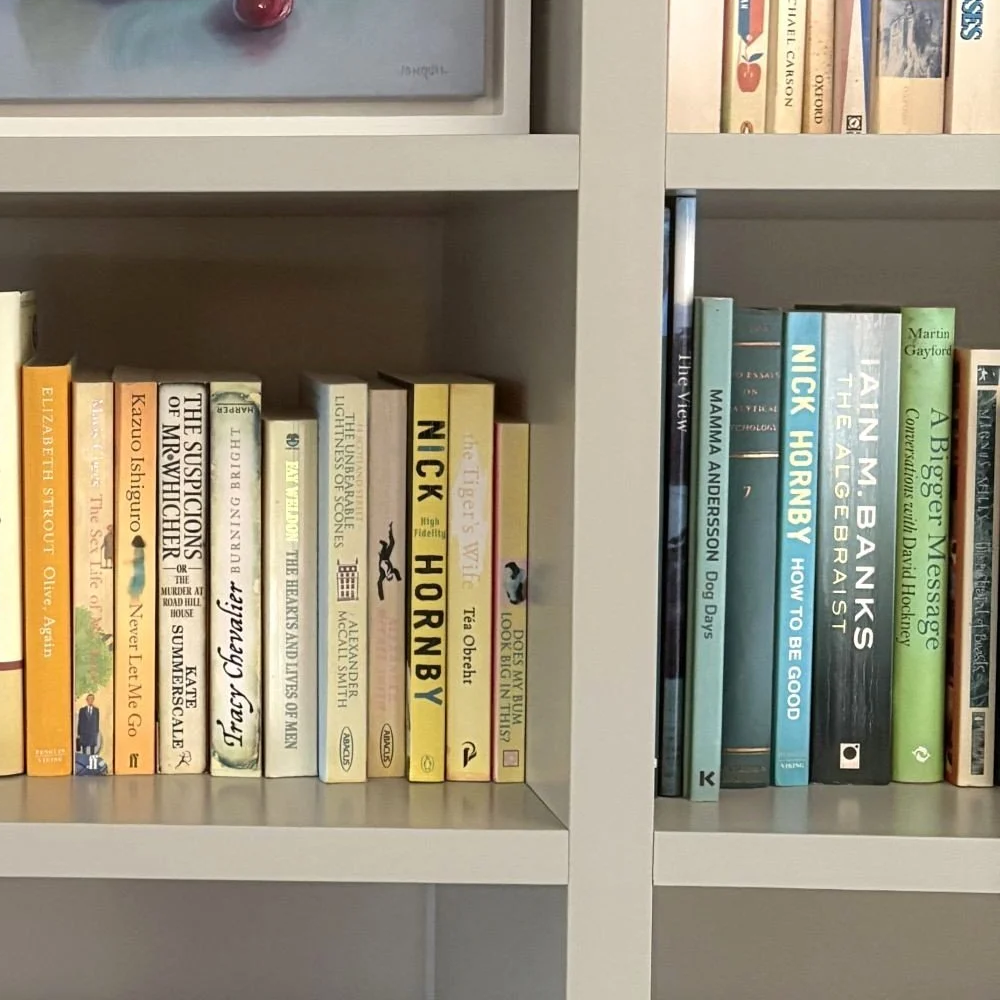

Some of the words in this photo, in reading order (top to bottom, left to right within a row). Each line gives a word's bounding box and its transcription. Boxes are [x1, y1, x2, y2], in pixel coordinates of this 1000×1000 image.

[783, 50, 797, 107] CARSON
[790, 344, 816, 414] NICK
[858, 359, 880, 441] IAIN
[130, 393, 145, 451] Kazuo
[184, 393, 202, 435] THE
[709, 390, 723, 455] MAMMA
[930, 408, 949, 427] A
[416, 421, 445, 502] NICK
[786, 430, 814, 544] HORNBY
[920, 437, 950, 527] Bigger
[126, 457, 145, 532] Ishiguro
[183, 442, 202, 560] SUSPICIONS
[706, 461, 722, 562] ANDERSSON
[702, 571, 717, 599] Dog
[790, 558, 804, 601] HOW
[853, 505, 875, 650] BANKS
[917, 535, 946, 650] Message
[129, 604, 143, 650] Never
[216, 581, 243, 678] Chevalier
[413, 555, 444, 706] HORNBY
[463, 608, 476, 630] Téa
[702, 605, 717, 639] Days
[790, 606, 803, 631] TO
[129, 655, 143, 681] Let
[463, 635, 476, 684] Obreht
[789, 636, 802, 661] BE
[128, 684, 142, 708] Me
[172, 625, 184, 749] SUMMERSCALE
[186, 666, 197, 709] KATE
[216, 684, 253, 747] Tracy
[786, 666, 801, 720] GOOD
[128, 714, 142, 737] Go
